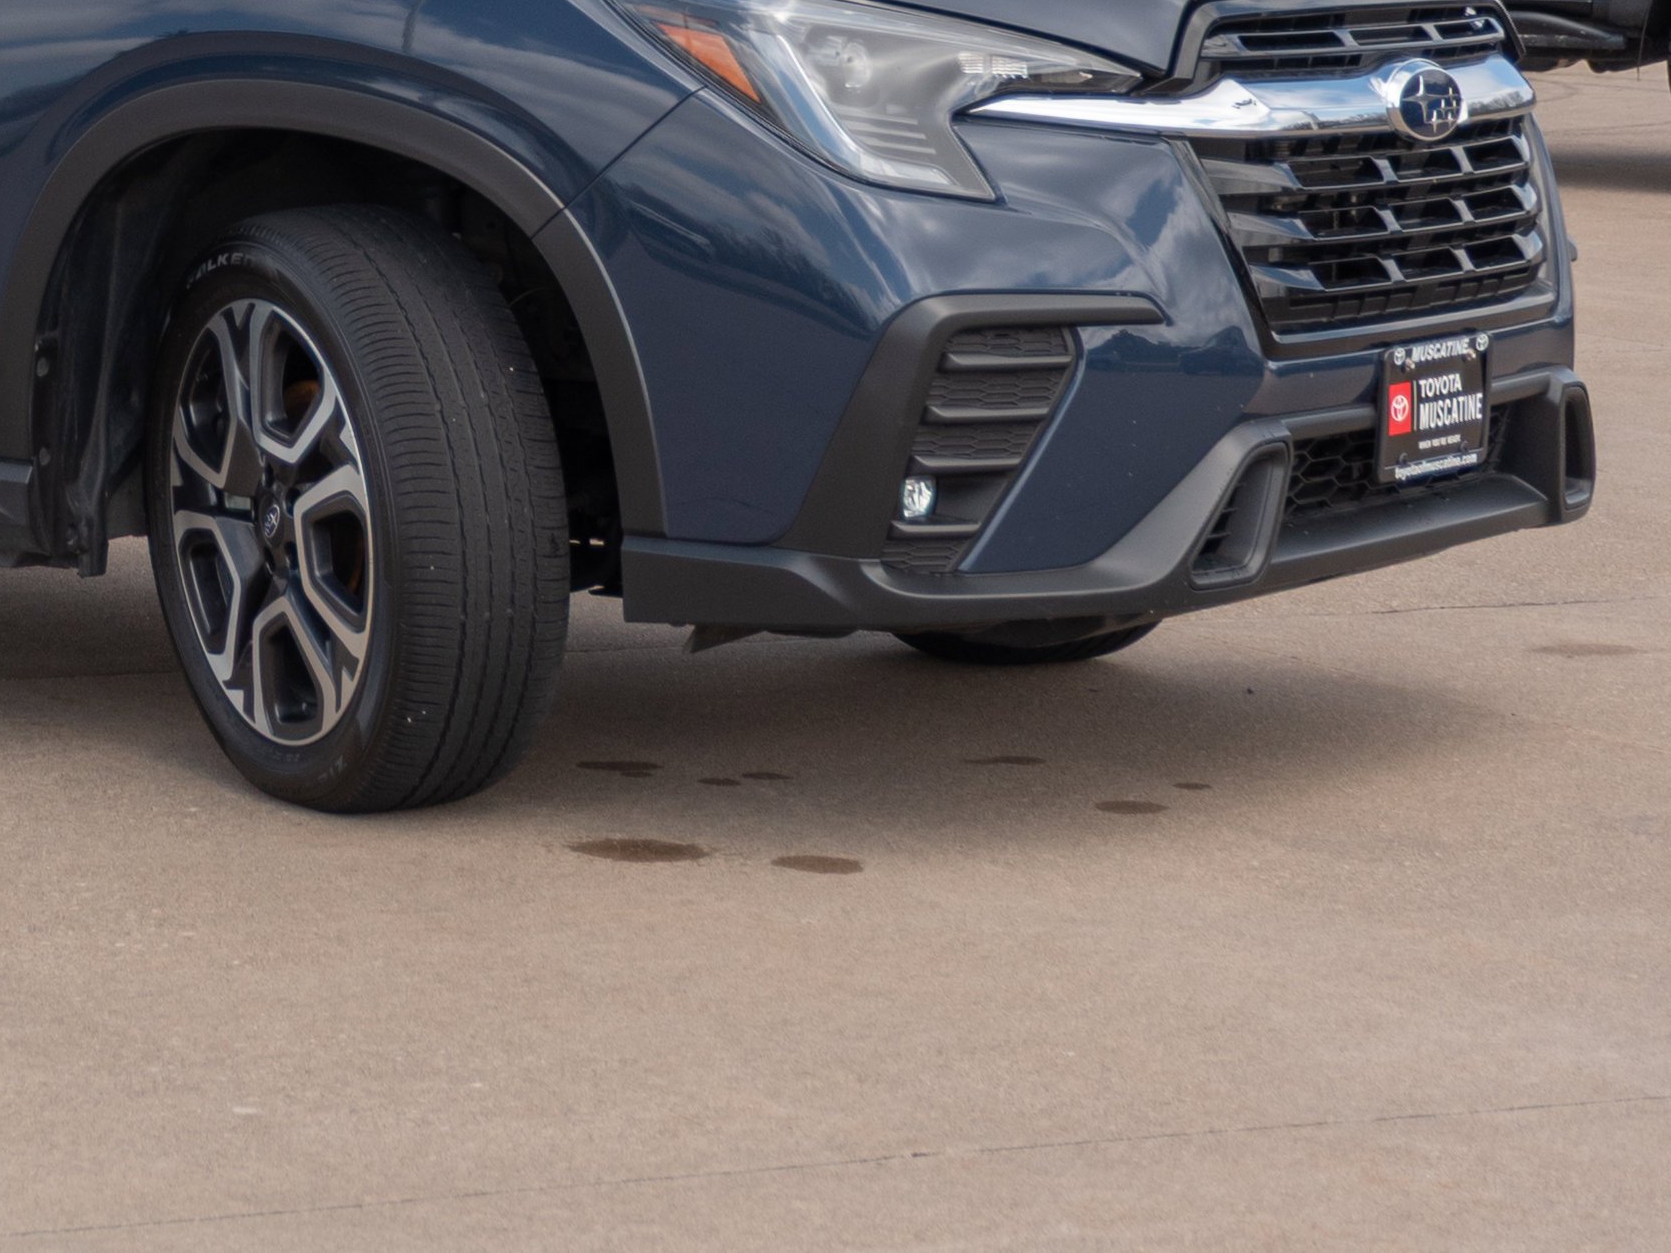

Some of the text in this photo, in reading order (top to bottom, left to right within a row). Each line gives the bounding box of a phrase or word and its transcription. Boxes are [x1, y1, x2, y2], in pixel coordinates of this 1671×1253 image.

[1410, 338, 1470, 363] MUSCATINE
[1418, 373, 1463, 398] TOYOTA
[1418, 392, 1483, 430] MUSCATINE
